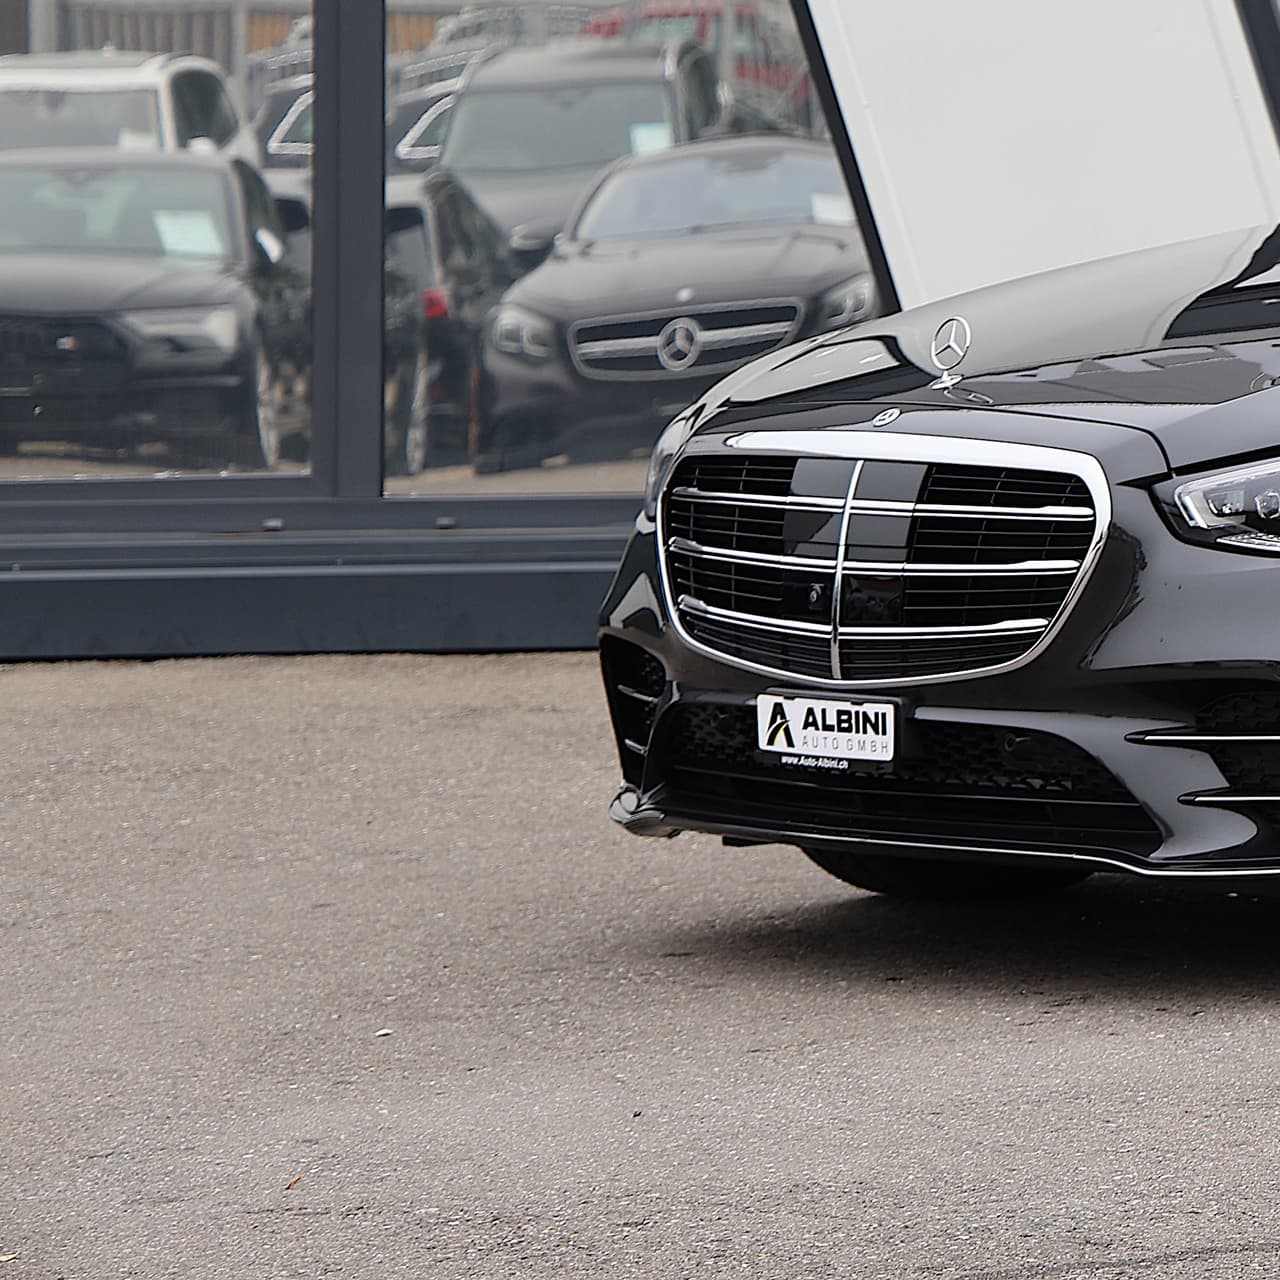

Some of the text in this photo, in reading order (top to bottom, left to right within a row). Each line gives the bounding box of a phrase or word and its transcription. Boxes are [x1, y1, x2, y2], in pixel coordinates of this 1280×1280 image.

[802, 706, 887, 736] ALBINI
[802, 735, 889, 753] AUTO GMBH
